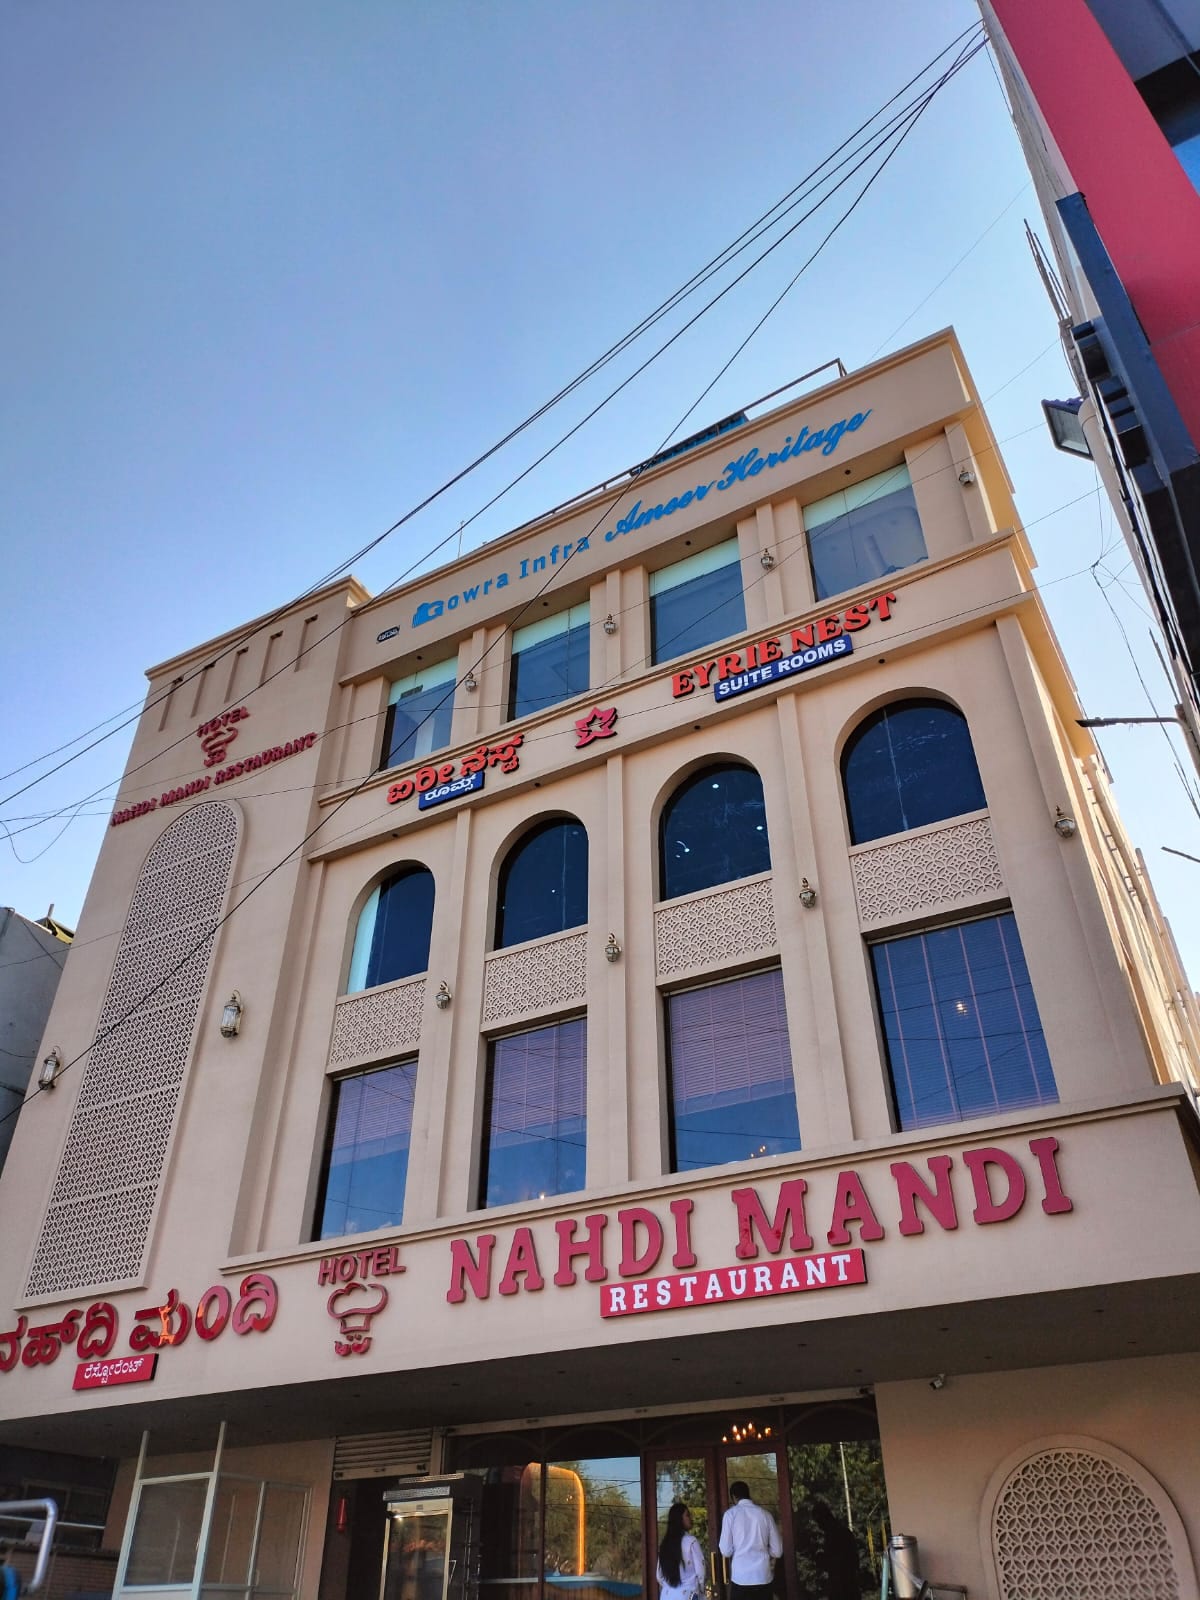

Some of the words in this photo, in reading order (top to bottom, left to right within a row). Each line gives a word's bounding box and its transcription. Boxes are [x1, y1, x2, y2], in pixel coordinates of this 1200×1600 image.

[412, 573, 509, 628] Gowra
[519, 537, 590, 579] Infra
[717, 409, 873, 490] Heritage
[672, 637, 783, 698] EYRIE
[790, 593, 897, 653] NEST
[719, 667, 772, 695] SUITE
[778, 639, 846, 673] ROOMS
[197, 706, 250, 737] HOTEL
[111, 797, 157, 826] NAHDI
[159, 776, 211, 807] MANDI
[213, 732, 317, 785] RESTAURANT
[447, 1199, 698, 1303] NAHDI
[731, 1136, 1074, 1259] MANDI
[317, 1247, 406, 1286] HOTEL
[610, 1254, 851, 1312] RESTAURANT
[129, 1273, 279, 1351] ಮಂದಿ
